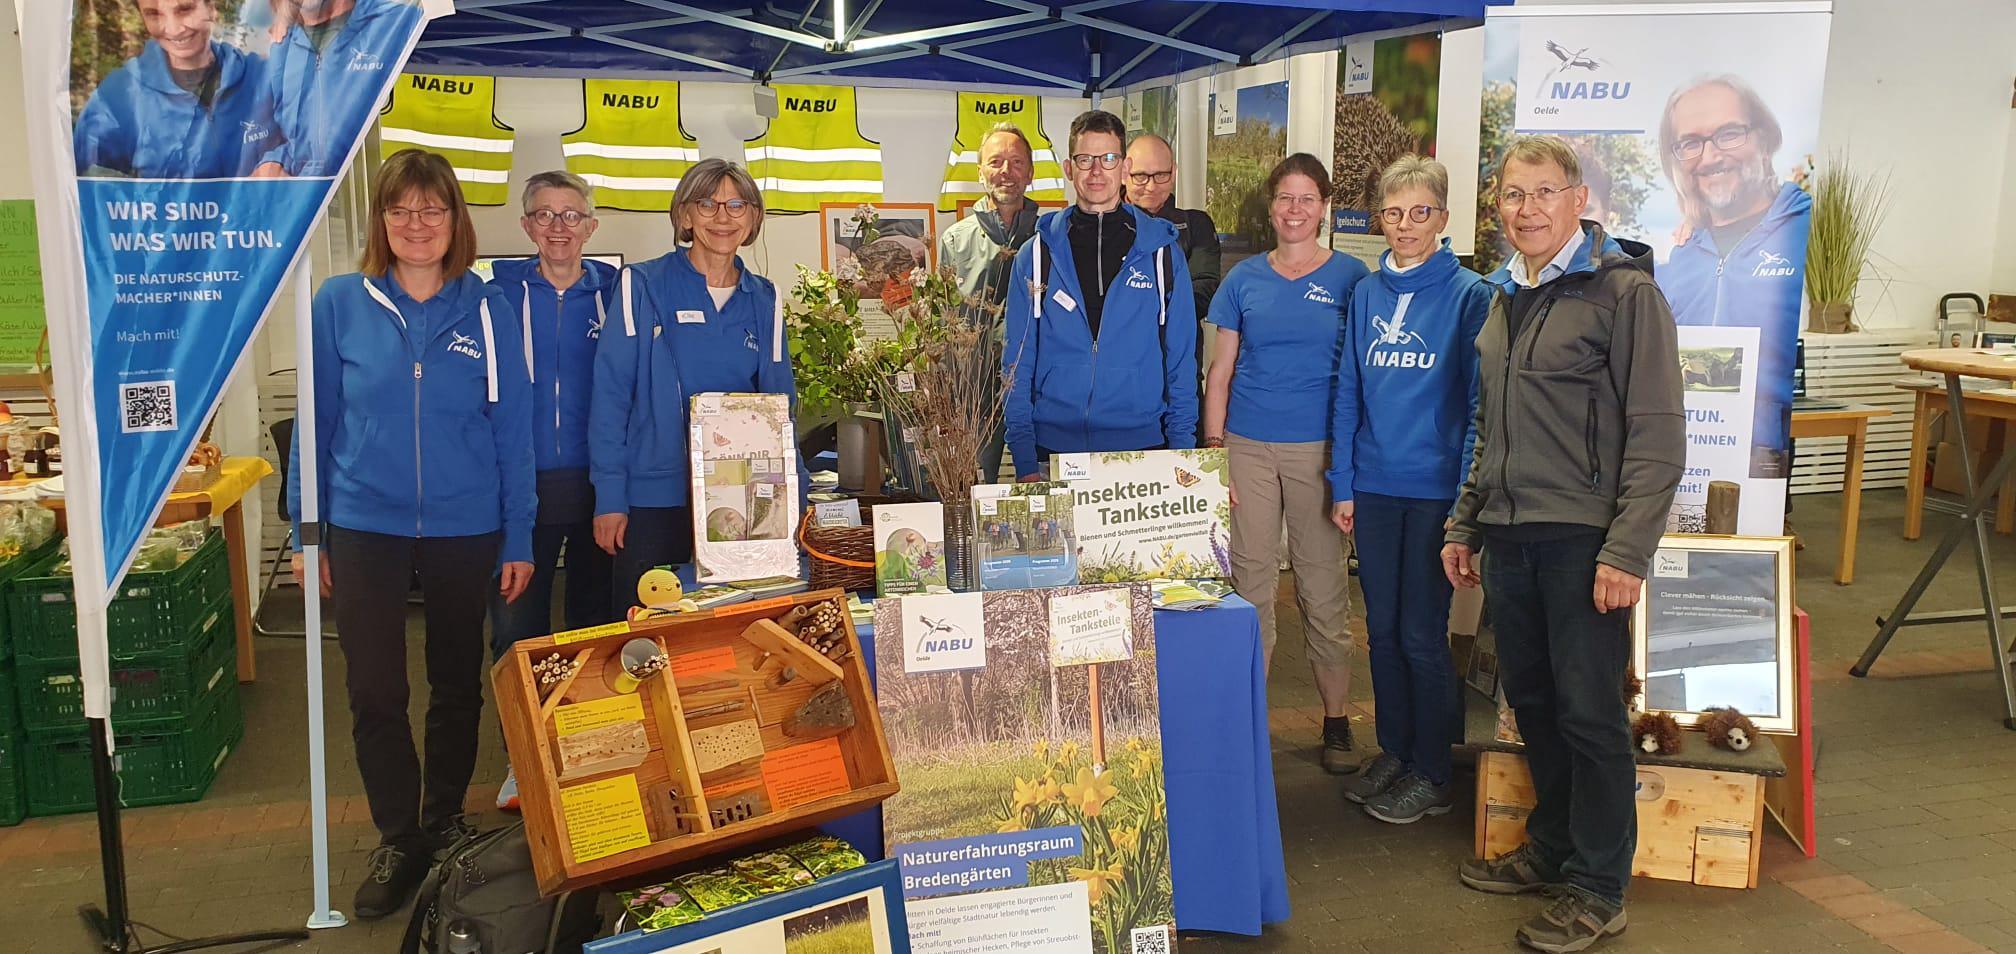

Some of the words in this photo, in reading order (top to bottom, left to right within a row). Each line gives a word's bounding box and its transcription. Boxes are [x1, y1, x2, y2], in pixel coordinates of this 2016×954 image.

[353, 63, 384, 71] NABU
[1352, 72, 1370, 82] NABU
[412, 75, 474, 96] NABU
[1550, 81, 1631, 100] NABU
[602, 93, 660, 109] NABU
[785, 96, 838, 113] NABU
[975, 99, 1025, 115] NABU
[1533, 106, 1560, 115] Oelde
[248, 130, 270, 141] NABU
[106, 201, 158, 221] WIR
[164, 201, 229, 224] SIND,
[1336, 216, 1367, 229] Igelschutz
[109, 232, 166, 252] WAS
[171, 231, 217, 251] WIR
[221, 229, 282, 249] TUN.
[114, 274, 137, 285] DIE
[139, 271, 245, 285] NATURSCHUTZ-
[1759, 267, 1796, 276] NABU
[1130, 280, 1153, 289] NABU
[1308, 293, 1335, 304] NABU
[117, 330, 151, 342] Mach
[155, 328, 180, 341] mit!
[453, 345, 482, 359] NABU
[1372, 351, 1436, 369] NABU
[1685, 409, 1726, 424] TUN.
[1071, 481, 1170, 507] Insekten-
[1675, 483, 1702, 494] mit!
[1097, 495, 1208, 526] Tankstelle
[1080, 534, 1103, 542] Bienen
[1103, 531, 1116, 539] und
[1117, 524, 1166, 537] Schmetterlinge
[1166, 519, 1209, 530] willkommen!
[1057, 608, 1103, 625] Insekten-
[1070, 615, 1121, 635] Tankstelle
[925, 638, 973, 653] NABU
[893, 827, 945, 841] Projektgruppe
[903, 836, 1075, 867] Naturerfahrungsraum
[904, 866, 1011, 890] Bredengärten
[927, 908, 934, 917] in
[935, 905, 956, 917] Oelde
[957, 902, 979, 913] lassen
[980, 898, 1016, 912] engagierte
[1017, 894, 1059, 907] Bürgerinnen
[1059, 891, 1073, 902] und
[929, 915, 962, 929] vielfältige
[963, 911, 999, 924] Stadtnatur
[1000, 907, 1029, 921] lebendig
[917, 938, 952, 951] Schaffung
[953, 937, 966, 945] von
[966, 931, 1008, 945] Blühflächen
[1008, 929, 1019, 940] für
[1020, 926, 1048, 938] Insekten
[926, 929, 942, 938] mit!
[1010, 938, 1031, 952] Pflege
[1032, 937, 1045, 946] von
[1046, 932, 1081, 945] Streuobst-
